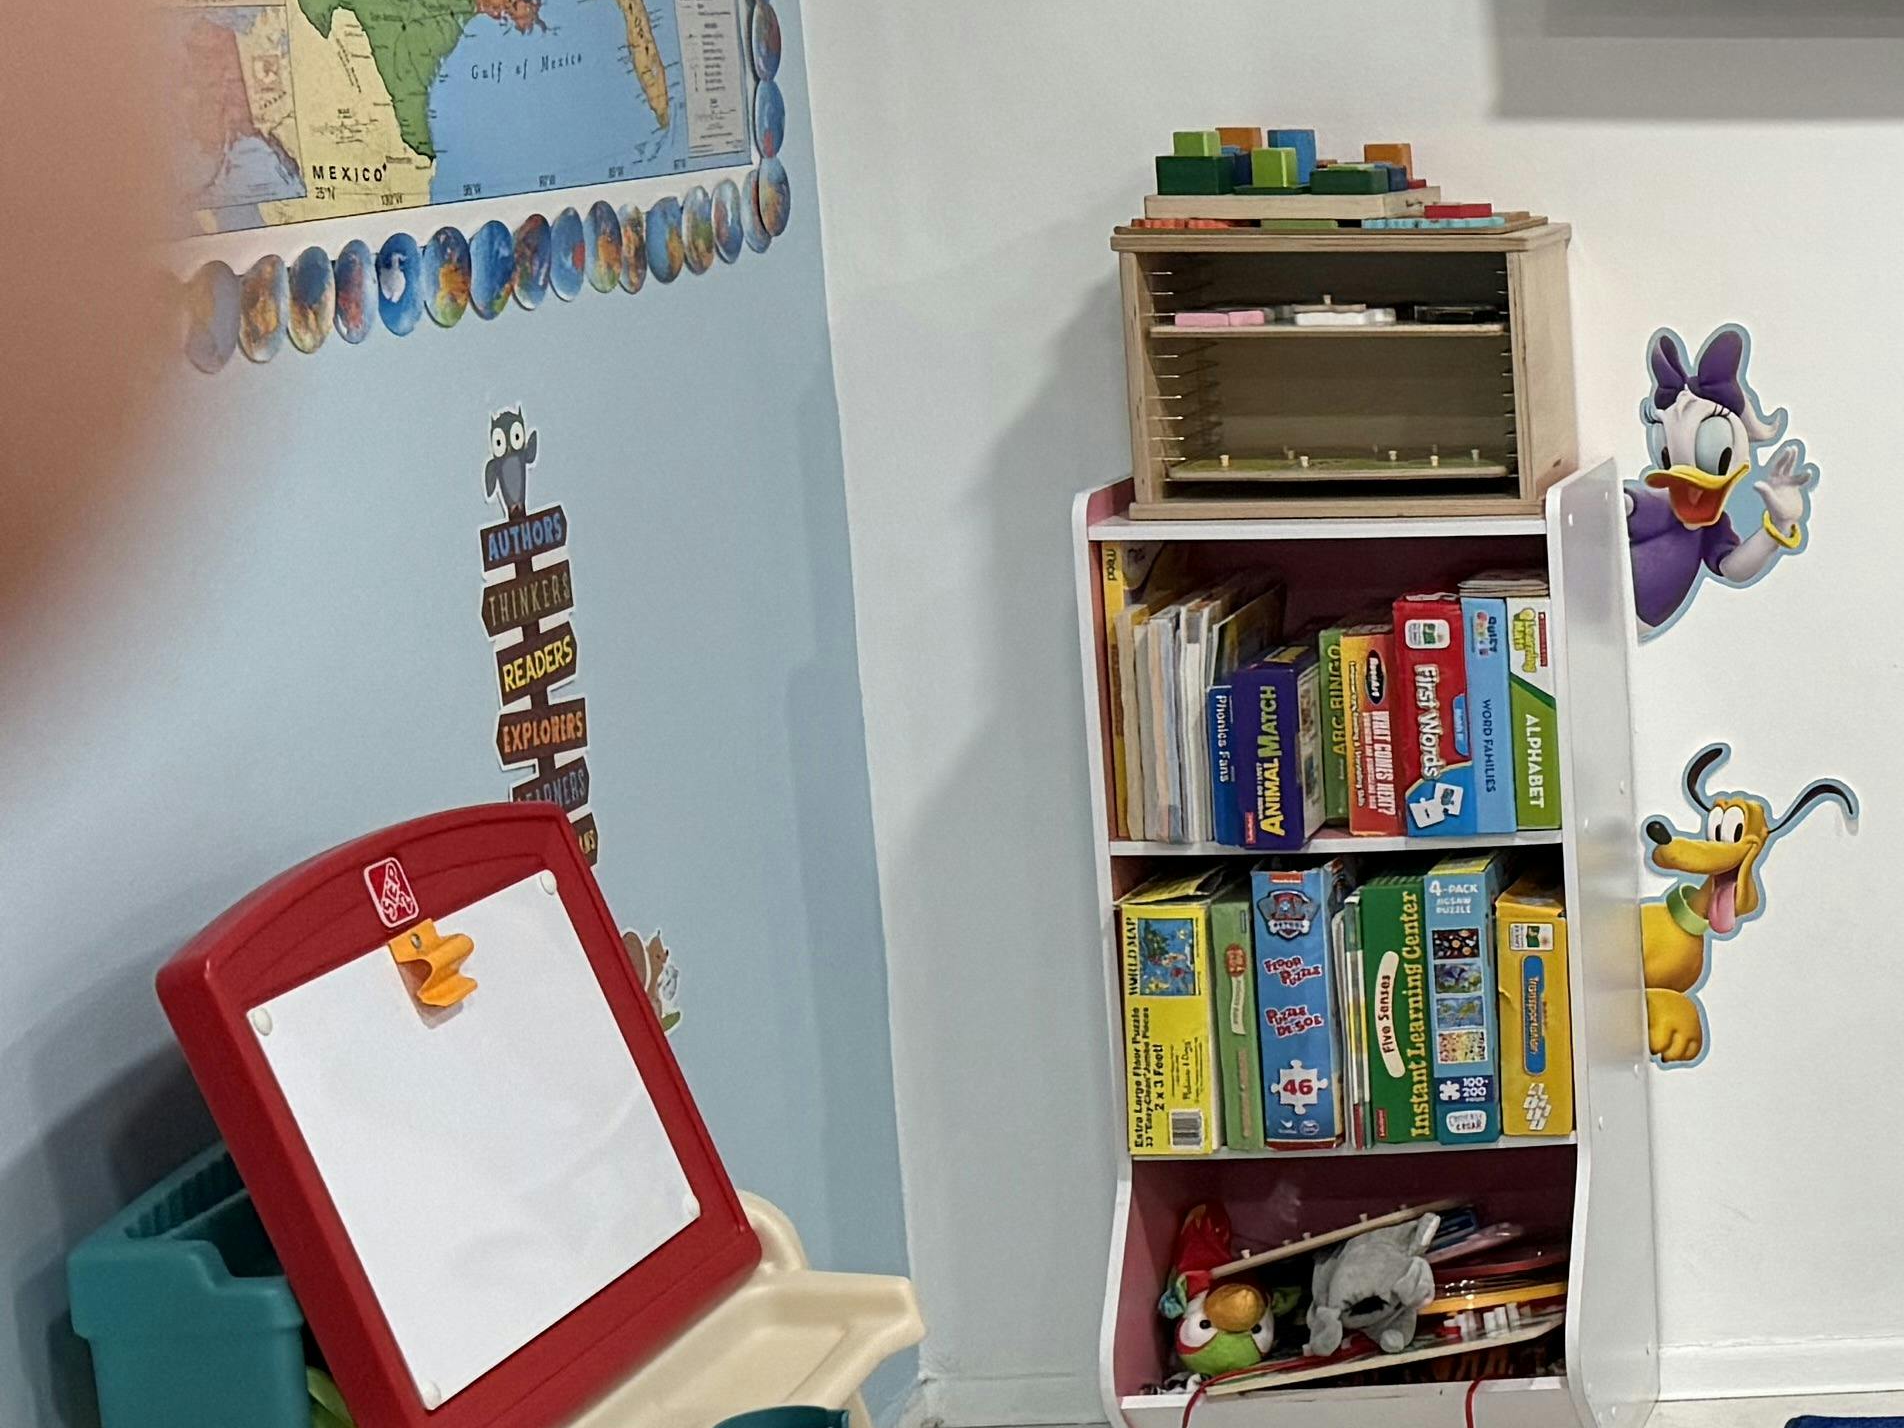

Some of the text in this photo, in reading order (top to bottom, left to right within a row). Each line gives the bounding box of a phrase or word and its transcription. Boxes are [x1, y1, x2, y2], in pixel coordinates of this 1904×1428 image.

[470, 52, 584, 82] Gulf of Mexico
[310, 165, 385, 184] MEXICO
[487, 512, 564, 562] AUTHORS
[489, 570, 571, 629] THINKERS
[503, 634, 573, 693] READERS
[503, 713, 584, 754] EXPLORERS
[1215, 693, 1231, 783] Phonics Fans
[1414, 664, 1444, 779] First Words
[1257, 685, 1285, 836] ANIMAL MATCH
[1372, 710, 1396, 815] WHAT COMES NEXT?
[1482, 699, 1496, 792] WORD FAMILIES
[1525, 713, 1544, 808] ALPHABET
[1428, 879, 1479, 897] 4-PACK
[1126, 917, 1138, 996] WORLD MAP
[1279, 965, 1322, 986] PUZZLE
[1131, 1007, 1141, 1044] Puzzle
[1265, 1005, 1307, 1026] PUZZLE
[1377, 974, 1395, 1053] Five Senses
[1400, 890, 1431, 1137] Instant Learning Center
[1132, 1048, 1142, 1077] Floor
[1133, 1080, 1144, 1113] Large
[1154, 1079, 1164, 1088] 3
[1282, 1078, 1314, 1096] 46
[1462, 1087, 1487, 1097] 200
[1154, 1103, 1164, 1111] 2
